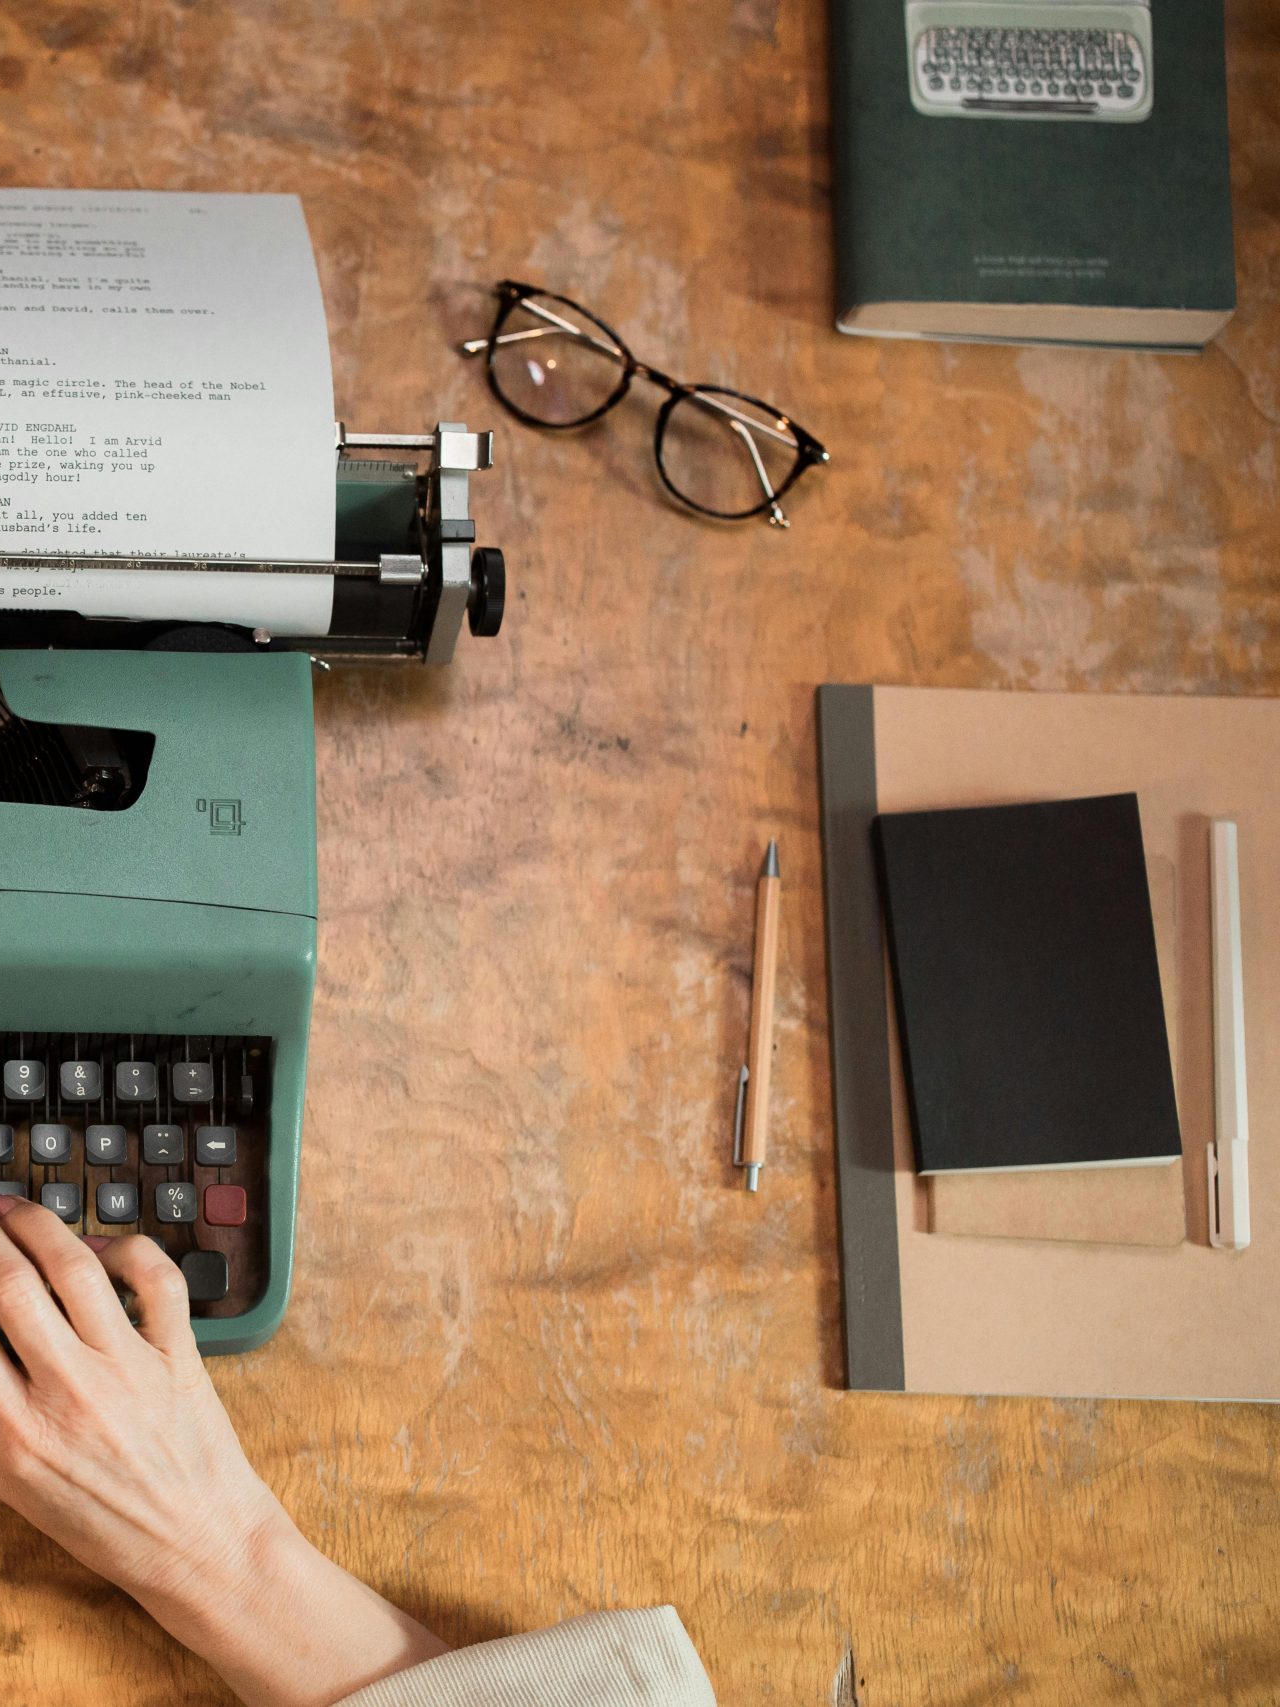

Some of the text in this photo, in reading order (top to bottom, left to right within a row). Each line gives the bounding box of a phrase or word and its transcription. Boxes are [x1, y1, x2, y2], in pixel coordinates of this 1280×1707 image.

[12, 378, 49, 388] magic
[56, 378, 106, 388] circle.
[114, 379, 136, 388] The
[143, 380, 173, 389] head
[179, 380, 194, 389] of
[201, 381, 223, 390] the
[229, 381, 267, 391] Nobel
[20, 390, 35, 398] an
[42, 389, 106, 400] effusive,
[115, 390, 202, 401] pink-cheeked
[208, 393, 231, 401] man
[25, 423, 77, 433] ENGDAHL
[31, 435, 73, 445] Hello!
[89, 436, 96, 445] I
[125, 436, 162, 446] Arvid
[16, 509, 43, 522] all,
[52, 512, 74, 523] you
[81, 510, 119, 521] added
[125, 512, 148, 522] ten
[12, 584, 70, 598] people.
[19, 1065, 29, 1078] 9
[46, 1137, 56, 1150] O
[101, 1138, 111, 1151] P
[56, 1196, 66, 1209] L
[111, 1196, 124, 1208] M
